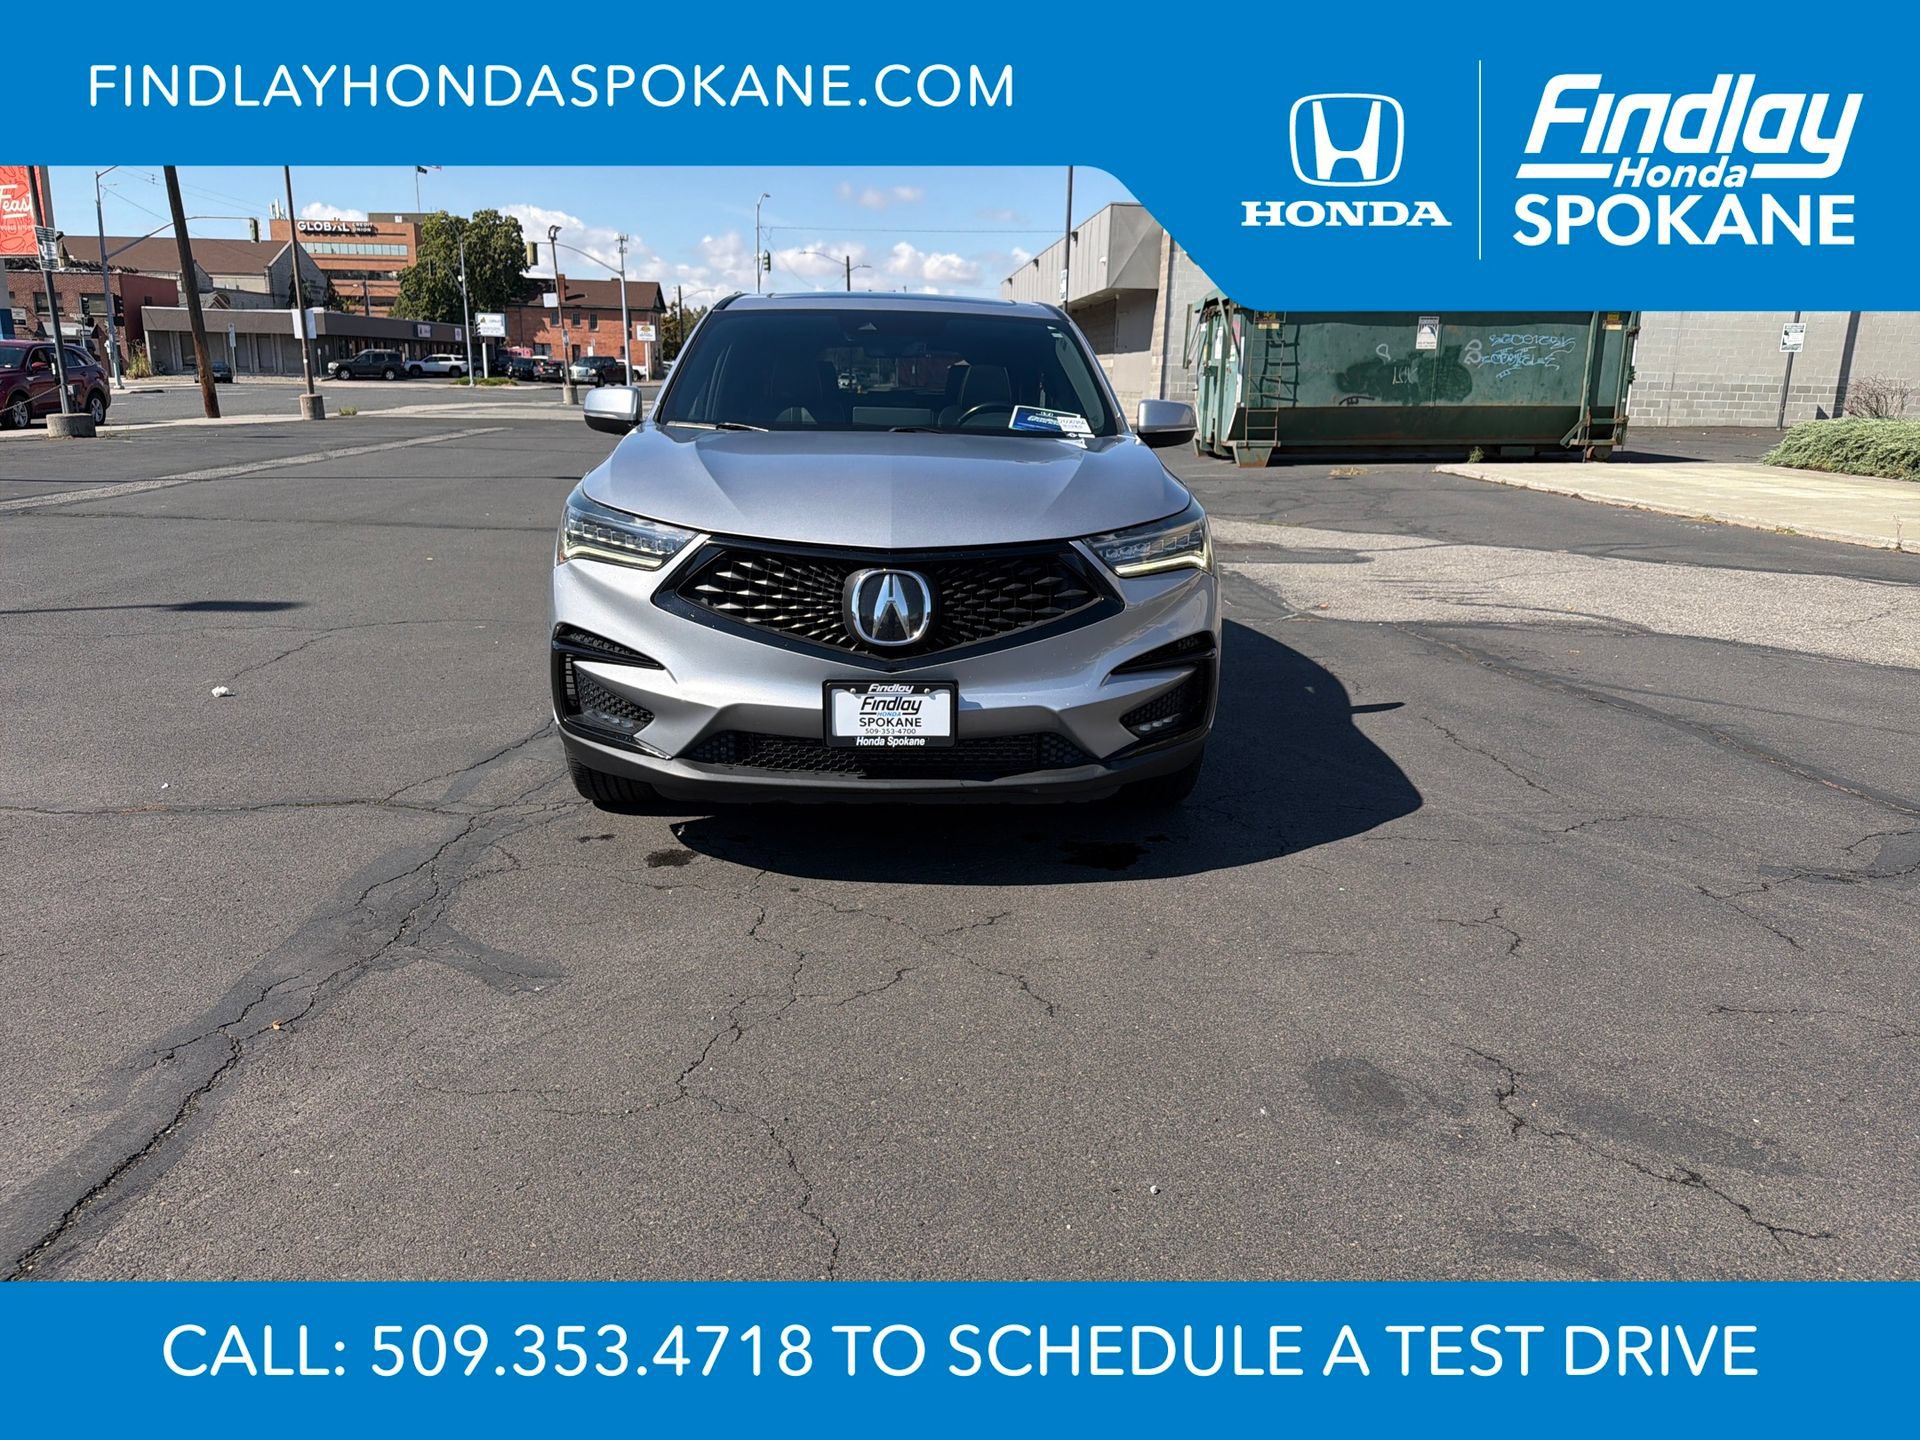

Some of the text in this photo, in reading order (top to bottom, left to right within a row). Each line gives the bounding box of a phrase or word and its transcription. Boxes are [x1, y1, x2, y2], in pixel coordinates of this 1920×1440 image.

[297, 221, 350, 232] GLOBAL
[868, 683, 914, 694] Findlay
[859, 696, 922, 715] Findlay
[859, 717, 922, 727] SPOKANE
[856, 736, 925, 748] Honda Spokane
